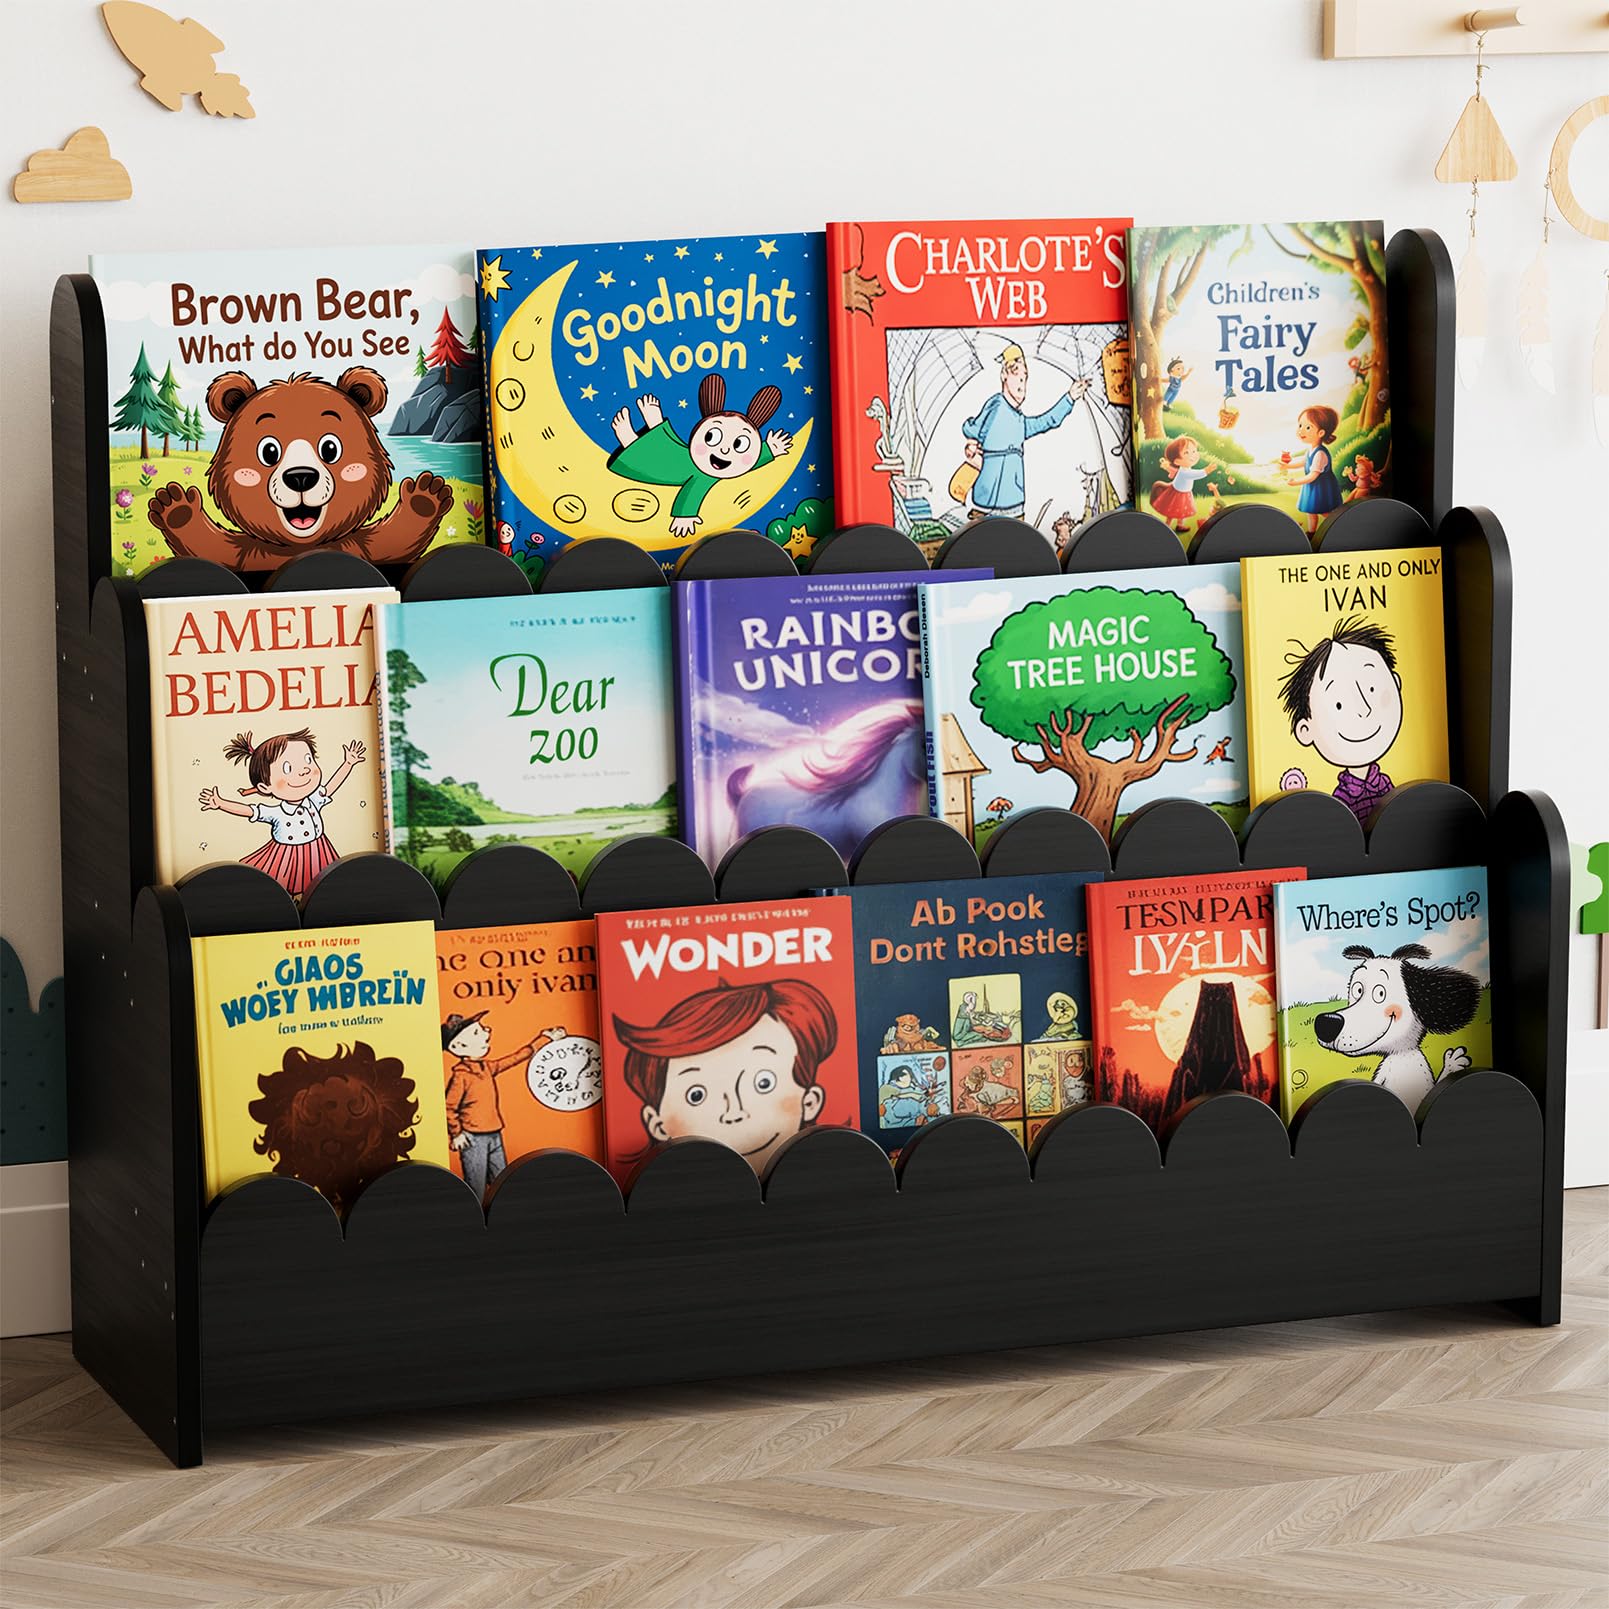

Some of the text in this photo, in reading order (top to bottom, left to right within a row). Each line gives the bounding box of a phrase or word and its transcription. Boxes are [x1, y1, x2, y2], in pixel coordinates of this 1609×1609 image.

[885, 226, 1126, 293] CHARLOTE'S
[171, 278, 420, 327] Brown Bear,
[965, 276, 1048, 320] WEB
[1207, 281, 1320, 305] Children's
[562, 273, 797, 366] Goodnight
[1216, 315, 1317, 357] Fairy
[178, 329, 411, 364] What do You See
[622, 339, 747, 389] Moon
[1215, 356, 1320, 397] Tales
[1278, 558, 1441, 583] THE ONE AND ONLY
[1324, 585, 1387, 612] IVAN
[168, 603, 374, 656] AMELIA
[1048, 615, 1150, 650] MAGIC
[921, 633, 930, 679] Deborah
[1007, 647, 1198, 690] TREE HOUSE
[489, 653, 615, 718] Dear
[910, 893, 1045, 927] Ab Pook
[1297, 891, 1480, 931] Where's Spot?
[620, 927, 833, 982] WONDER
[870, 936, 947, 965] Dont
